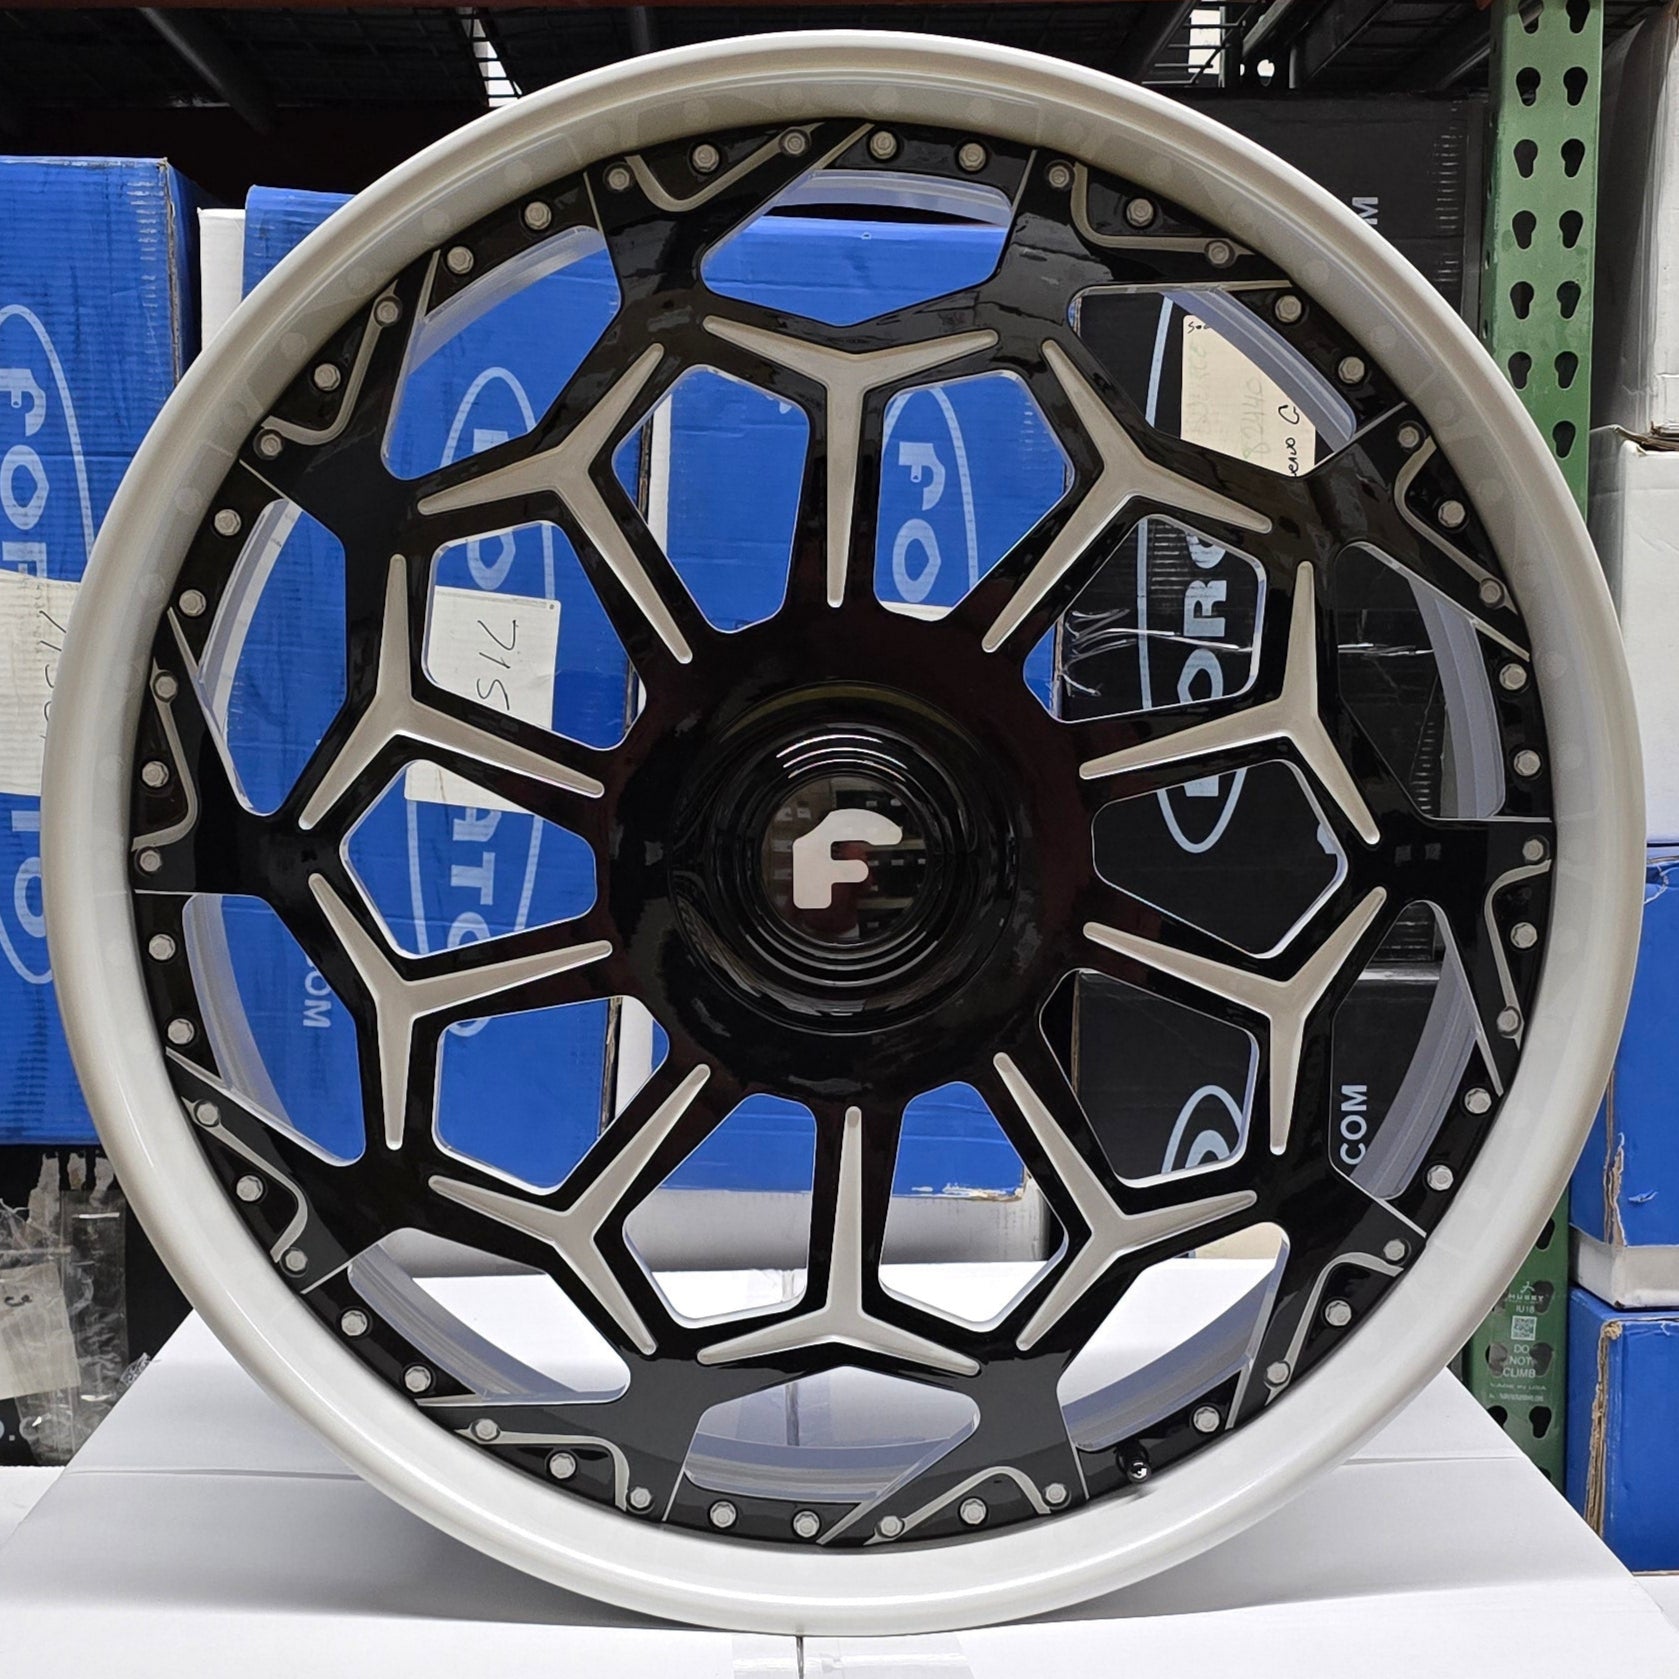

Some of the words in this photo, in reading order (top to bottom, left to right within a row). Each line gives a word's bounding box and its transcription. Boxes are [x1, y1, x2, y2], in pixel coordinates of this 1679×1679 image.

[302, 955, 332, 1028] OM
[1339, 1084, 1368, 1165] COM
[1513, 1344, 1530, 1354] DO
[1510, 1356, 1533, 1366] NOT
[1502, 1367, 1537, 1379] CLIMB
